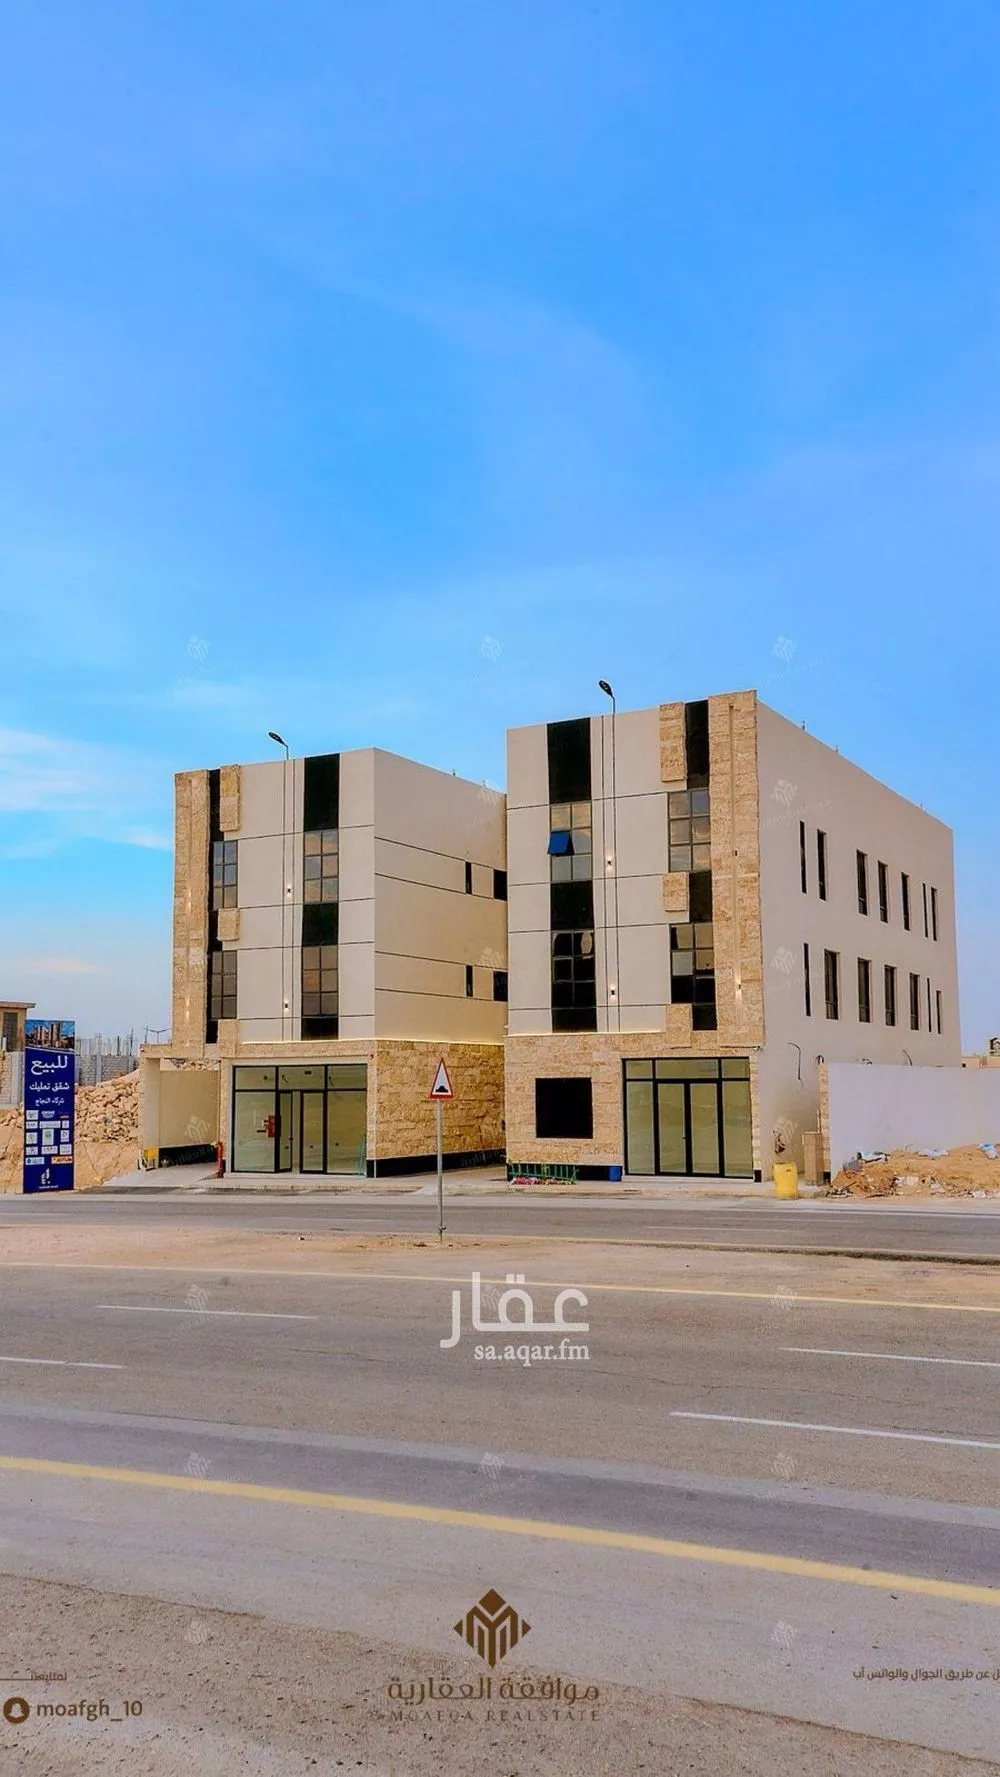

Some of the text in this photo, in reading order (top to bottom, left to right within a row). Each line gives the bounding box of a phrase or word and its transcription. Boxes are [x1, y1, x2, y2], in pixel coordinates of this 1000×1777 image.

[31, 1054, 68, 1075] للبيع
[29, 1081, 70, 1092] شقق تمليك
